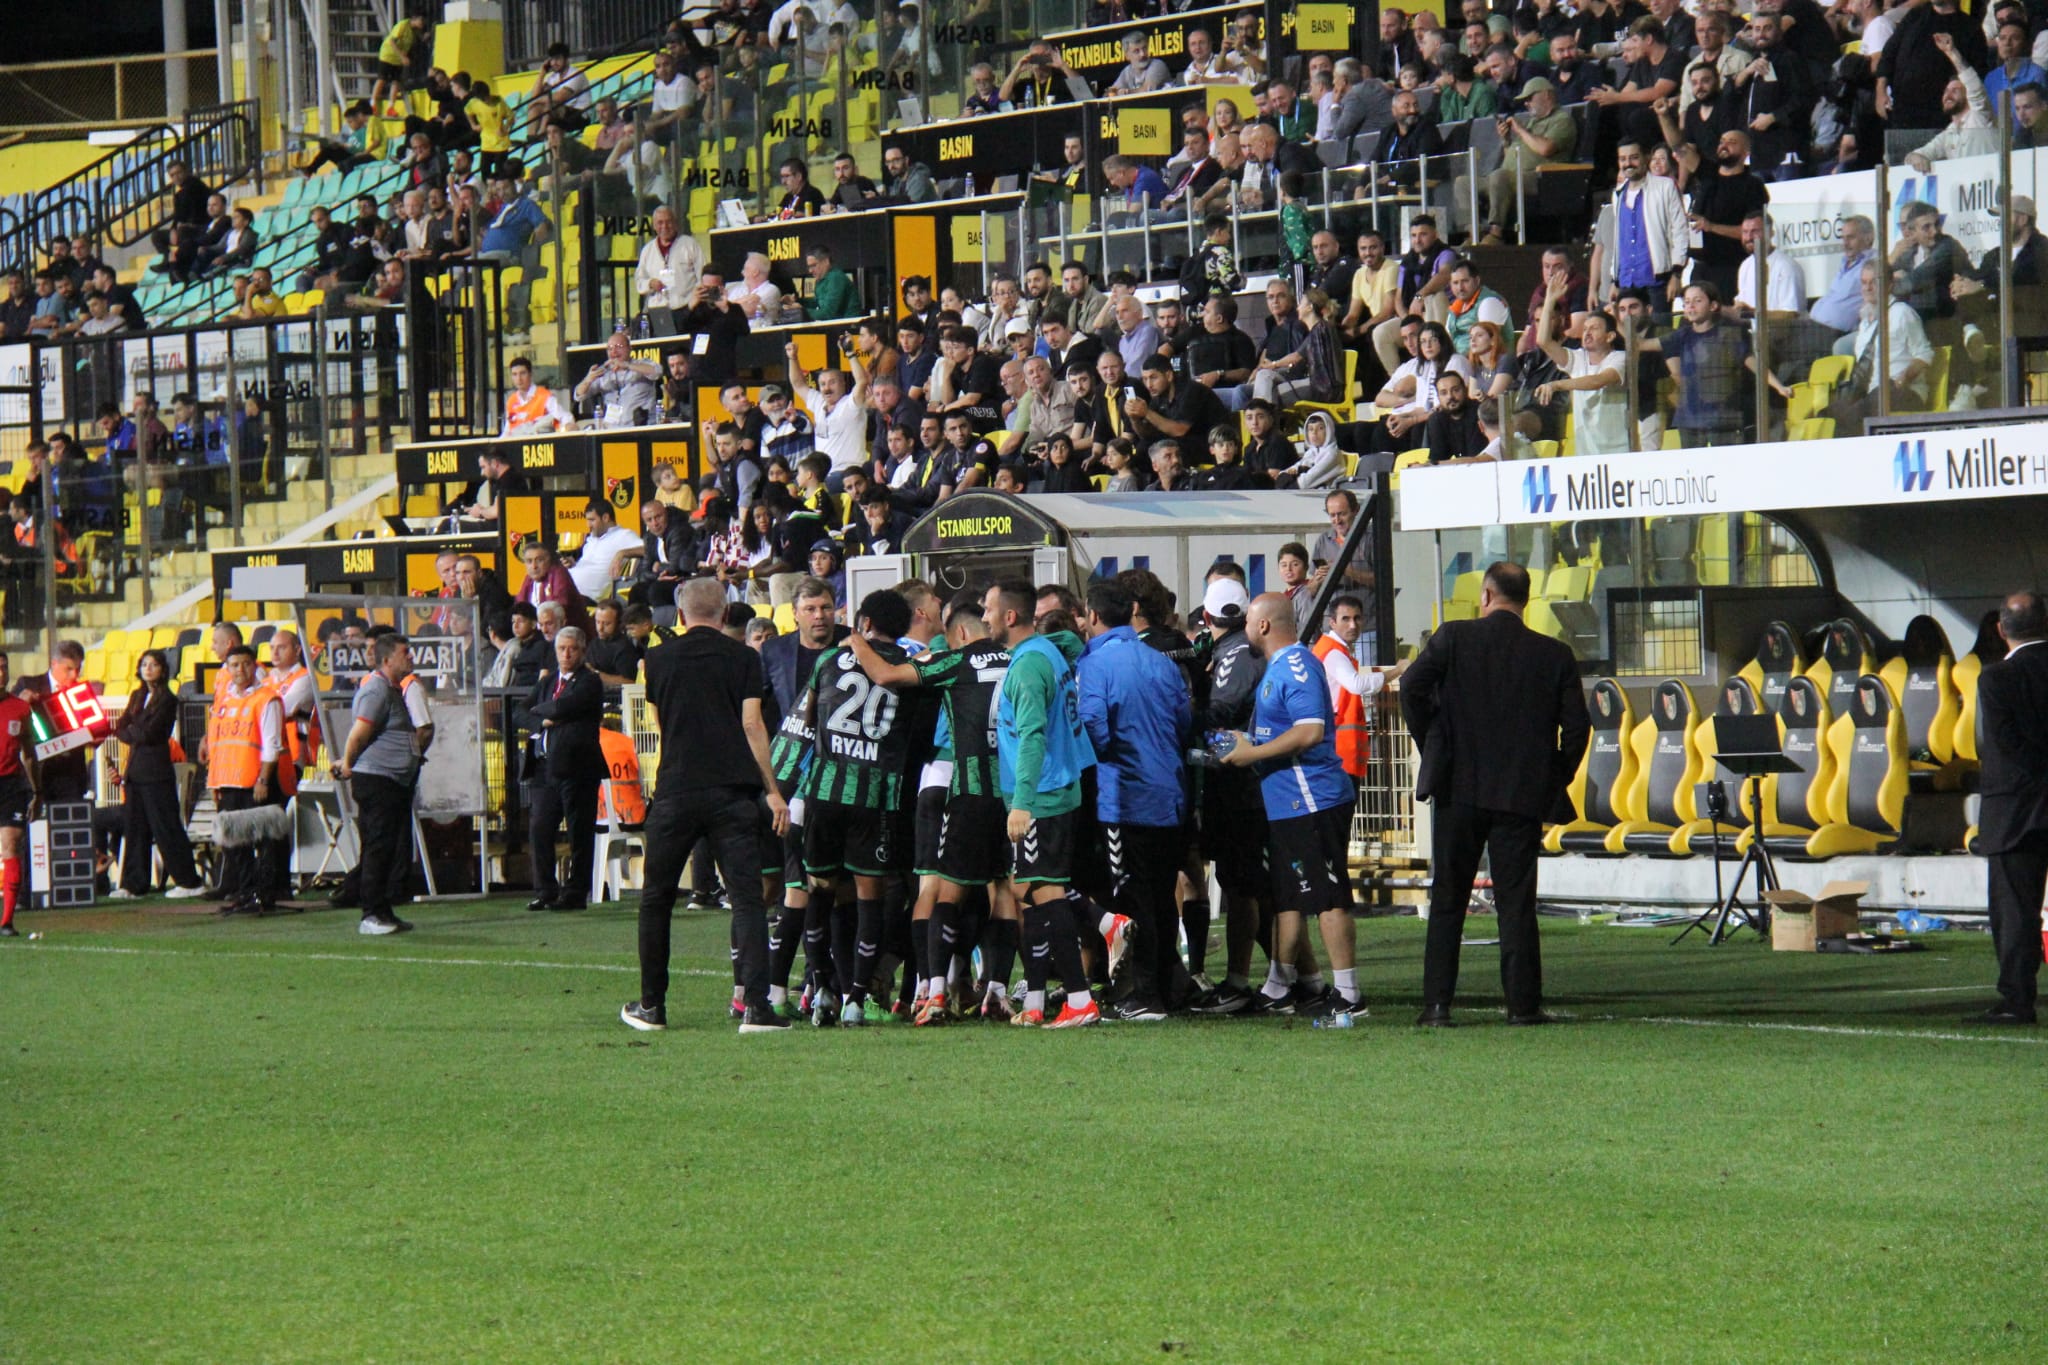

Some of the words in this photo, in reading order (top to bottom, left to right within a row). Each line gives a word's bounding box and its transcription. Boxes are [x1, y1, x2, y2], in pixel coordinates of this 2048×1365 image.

[1311, 19, 1335, 33] BASIN
[1061, 40, 1125, 69] İSTANBULS
[1133, 124, 1157, 138] BASIN
[940, 135, 973, 161] BASIN
[1958, 178, 2004, 212] Mill
[1782, 211, 1844, 245] KURTOĞ
[768, 236, 800, 262] BASIN
[427, 450, 458, 475] BASIN
[523, 443, 555, 468] BASIN
[1946, 437, 2027, 490] Miller
[1566, 463, 1636, 512] Miller
[936, 516, 1012, 538] İSTANBULSPOR
[342, 549, 374, 573] BASIN
[409, 645, 450, 667] VAR
[58, 683, 105, 730] 15
[826, 671, 899, 740] 20
[831, 734, 879, 762] RYAN
